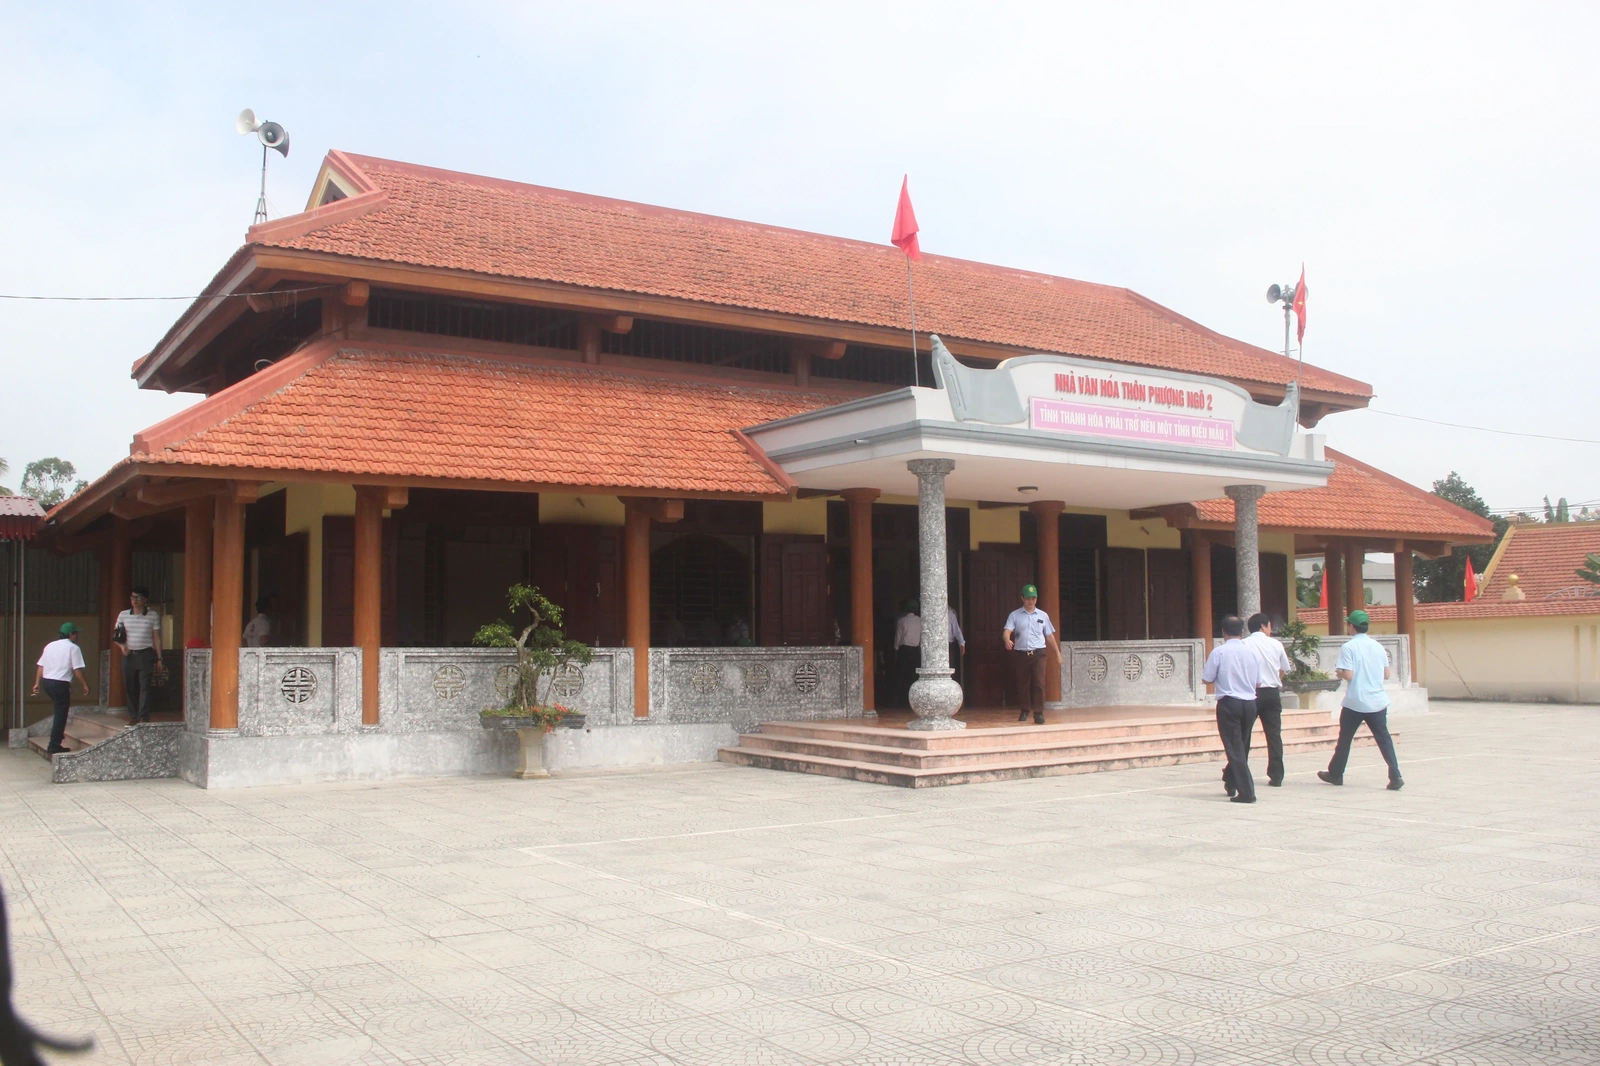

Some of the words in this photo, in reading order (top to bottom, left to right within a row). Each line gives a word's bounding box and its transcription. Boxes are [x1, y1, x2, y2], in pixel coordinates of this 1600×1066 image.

[1055, 371, 1076, 394] NHÀ
[1078, 375, 1098, 396] VĂN
[1100, 374, 1120, 399] HÓA
[1121, 380, 1146, 402] THÔN
[1148, 386, 1184, 409] PHƯỢNG
[1187, 390, 1205, 409] NGÔ
[1207, 394, 1213, 411] 2
[1040, 404, 1058, 423] TỈNH
[1060, 410, 1086, 426] THANH
[1088, 412, 1103, 428] HÓA
[1105, 412, 1123, 430] PHẢI
[1124, 414, 1140, 432] TRỞ
[1140, 418, 1155, 433] NÊN
[1157, 420, 1172, 437] MỘT
[1174, 420, 1190, 437] TỈNH
[1209, 424, 1224, 440] MẪU
